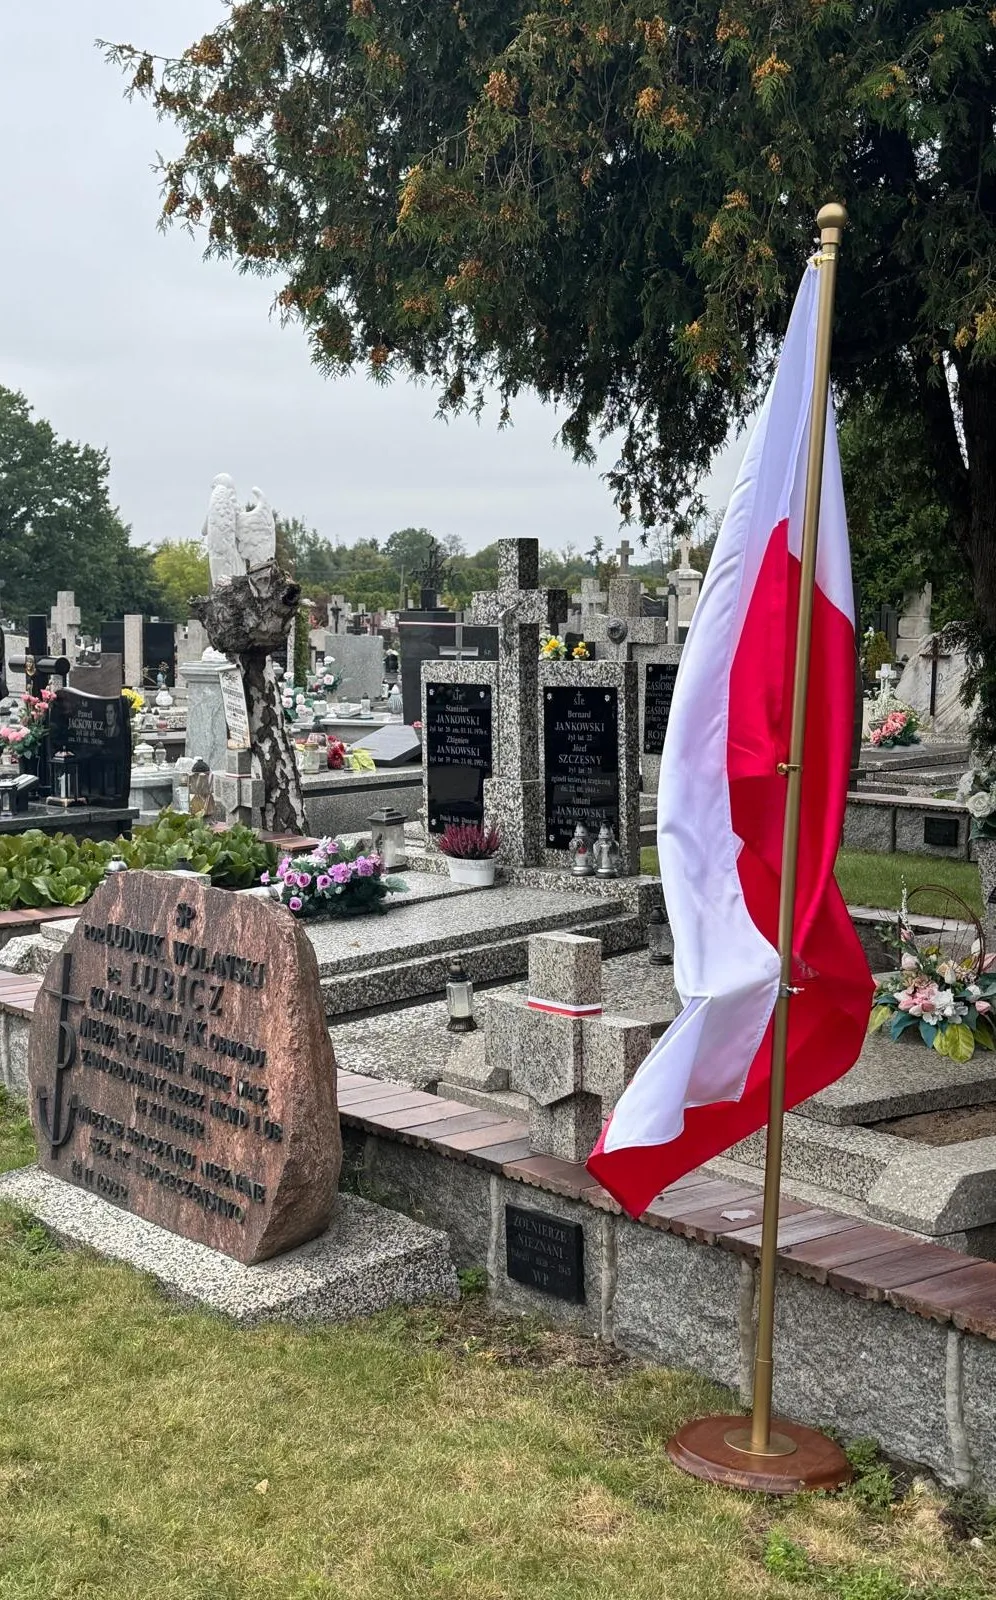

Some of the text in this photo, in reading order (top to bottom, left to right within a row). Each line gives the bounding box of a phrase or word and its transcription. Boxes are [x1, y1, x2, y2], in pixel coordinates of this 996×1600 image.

[436, 714, 480, 726] JANKOWSKI
[567, 710, 591, 718] Bernard
[68, 718, 104, 731] JACKOWICZ
[555, 721, 605, 732] JANKOWSKI
[437, 745, 480, 757] JANKOWSKI
[572, 743, 587, 752] Józef
[559, 754, 602, 766] SZCZĘSNY
[556, 805, 605, 818] JANKOWSKI
[105, 923, 165, 962] LUDWIK
[131, 961, 224, 1015] LUBICZ
[90, 986, 182, 1035] KOMENDANT
[82, 1048, 166, 1096] ZAMORDOWANY
[168, 1083, 205, 1112] PRZEZ
[209, 1100, 249, 1129] NKWD
[78, 1104, 266, 1204] MIEJSCE SPOCZYNKU NIEZNANE
[516, 1232, 564, 1260] NIEZNANI
[532, 1268, 550, 1287] WP
